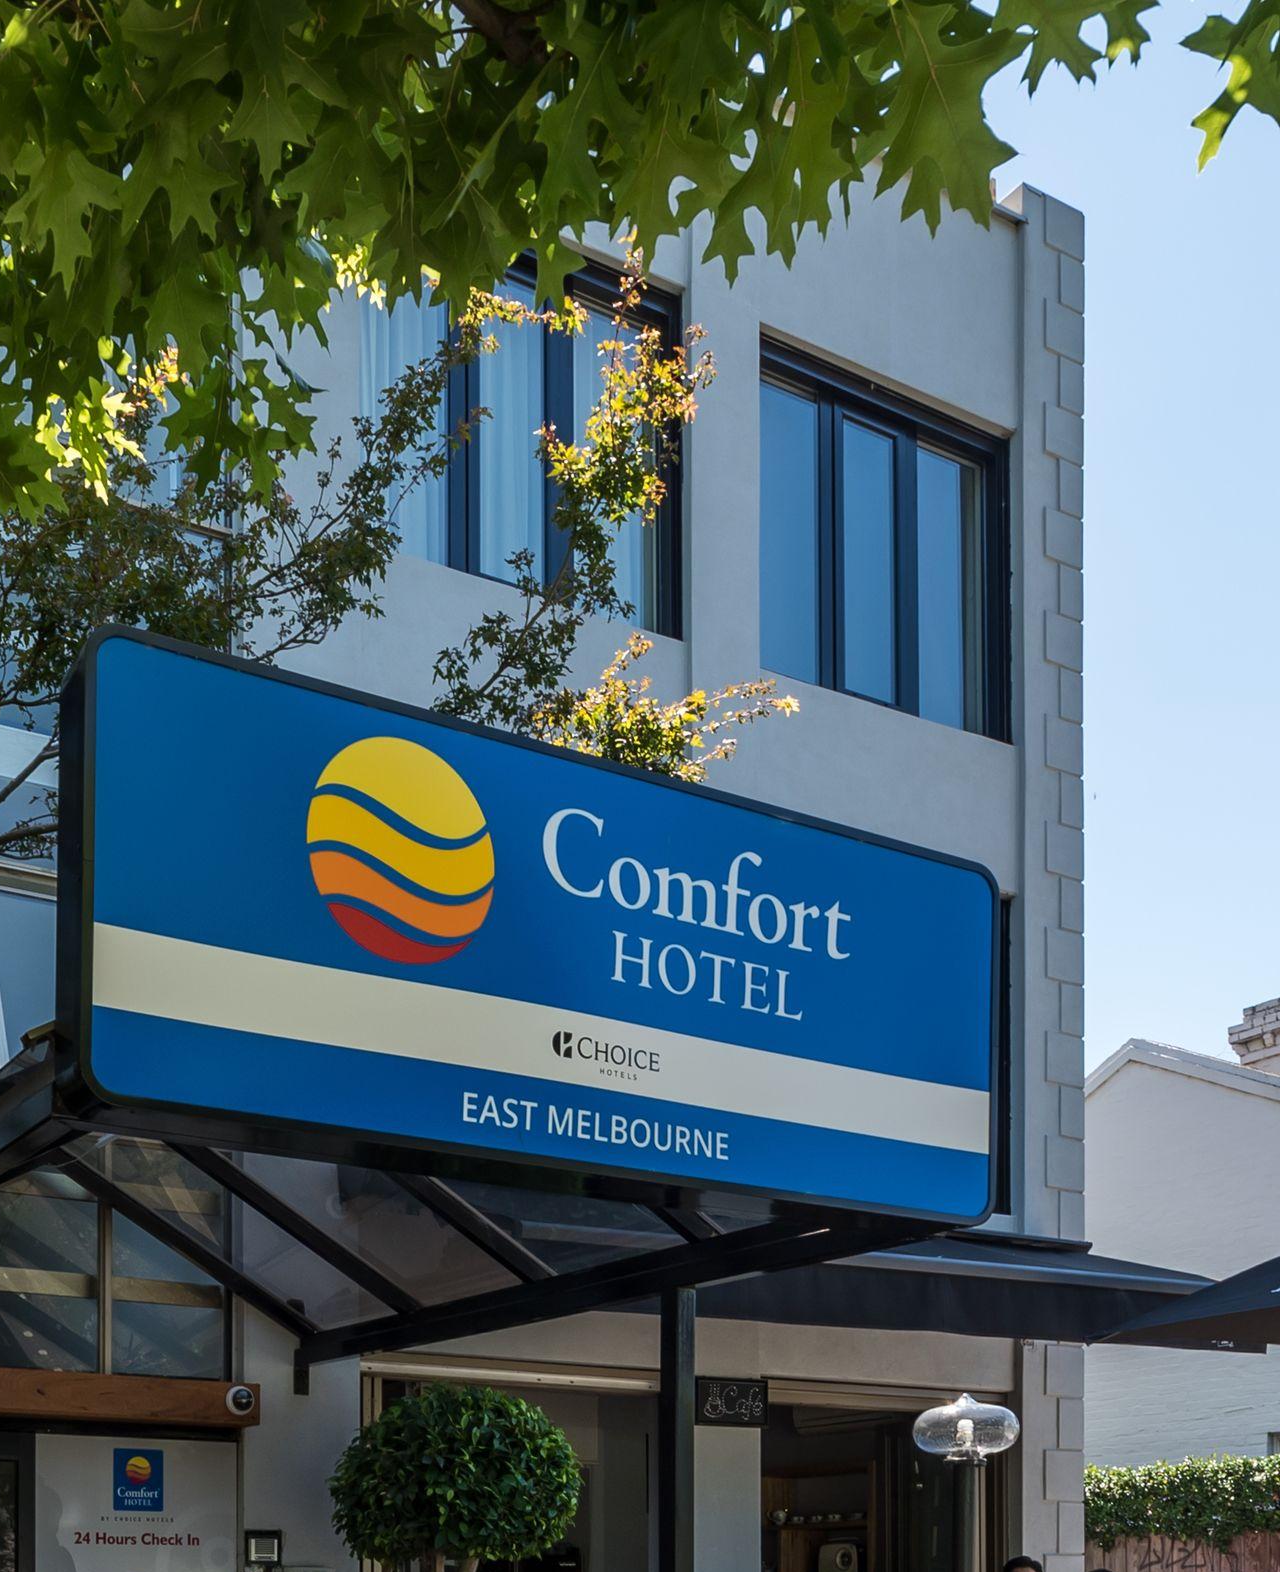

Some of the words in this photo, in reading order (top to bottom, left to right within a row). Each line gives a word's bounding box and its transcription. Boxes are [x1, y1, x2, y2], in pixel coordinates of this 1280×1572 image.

[542, 807, 852, 960] Comfort
[610, 929, 803, 1021] HOTEL
[576, 1036, 661, 1073] CHOICE
[599, 1067, 638, 1081] HOTELS
[462, 1091, 539, 1132] EAST
[547, 1104, 730, 1161] MELBOURNE
[117, 1486, 159, 1498] Comfort
[124, 1498, 153, 1506] HOTEL
[74, 1531, 91, 1545] 24
[95, 1532, 138, 1546] Hours
[141, 1533, 184, 1546] Check
[187, 1533, 200, 1546] In
